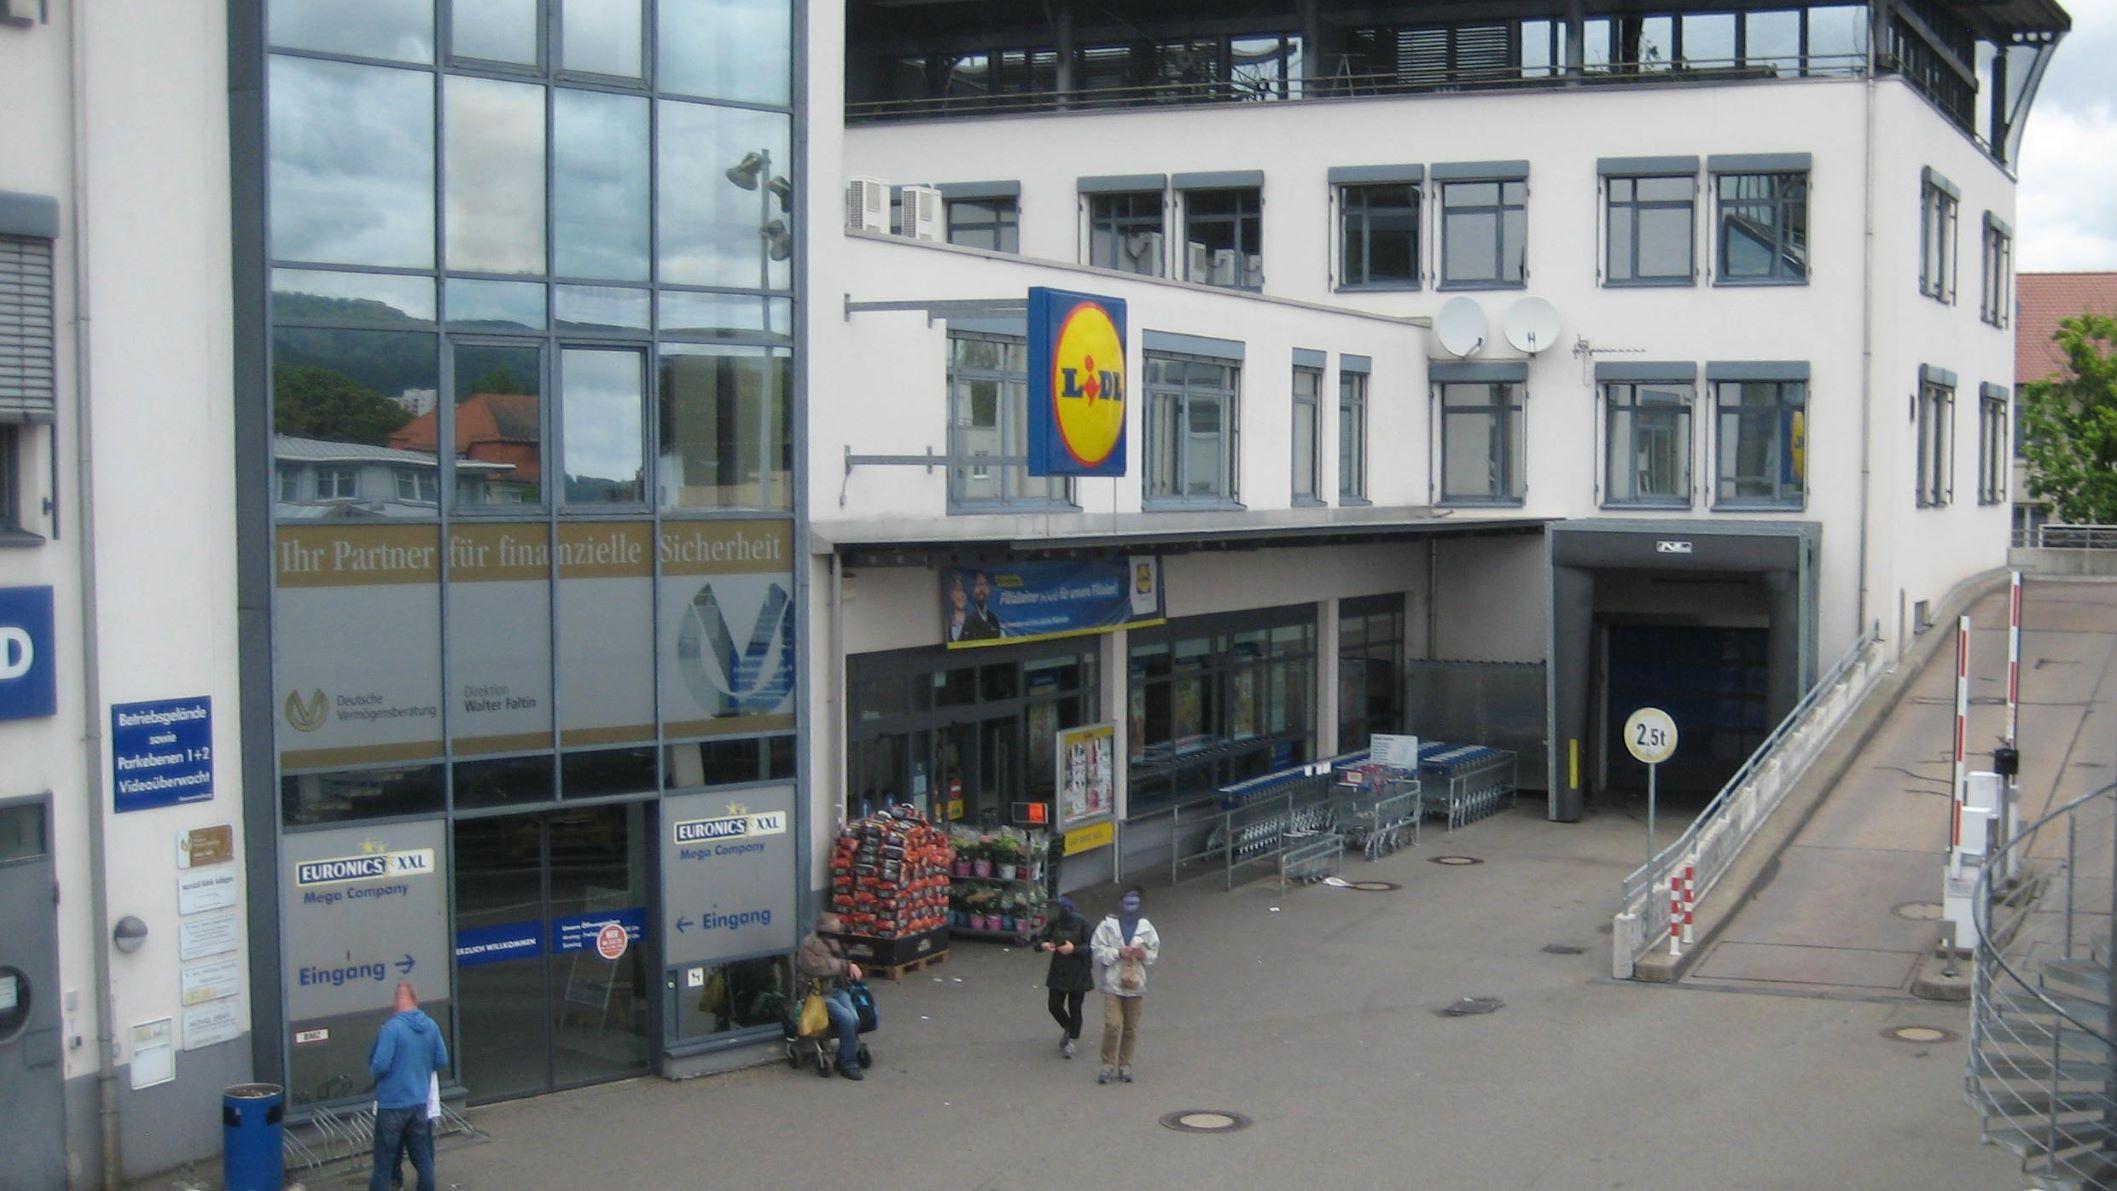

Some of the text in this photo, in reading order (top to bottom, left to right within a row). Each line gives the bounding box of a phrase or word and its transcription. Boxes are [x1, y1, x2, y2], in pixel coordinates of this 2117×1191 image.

[1061, 354, 1122, 407] LIDL
[280, 531, 781, 572] Ihr Partner für finanzielle Sicherheit
[336, 692, 383, 706] Deutsche
[464, 683, 509, 698] Direktion
[336, 706, 437, 722] Vermögensberatung
[465, 696, 537, 713] Walter Faltin
[119, 705, 207, 727] Betriebsgelände
[149, 731, 177, 745] sowie
[118, 746, 210, 770] Parkebenen 1+2
[119, 770, 210, 793] Videoüberwacht
[679, 816, 780, 840] EURONICS XXL
[680, 842, 765, 860] Mega Company
[301, 853, 426, 881] EURONICS XXL
[303, 883, 409, 904] Mega Company
[703, 909, 771, 930] Eingang
[456, 944, 486, 956] ERZLICH
[299, 962, 386, 986] Eingang
